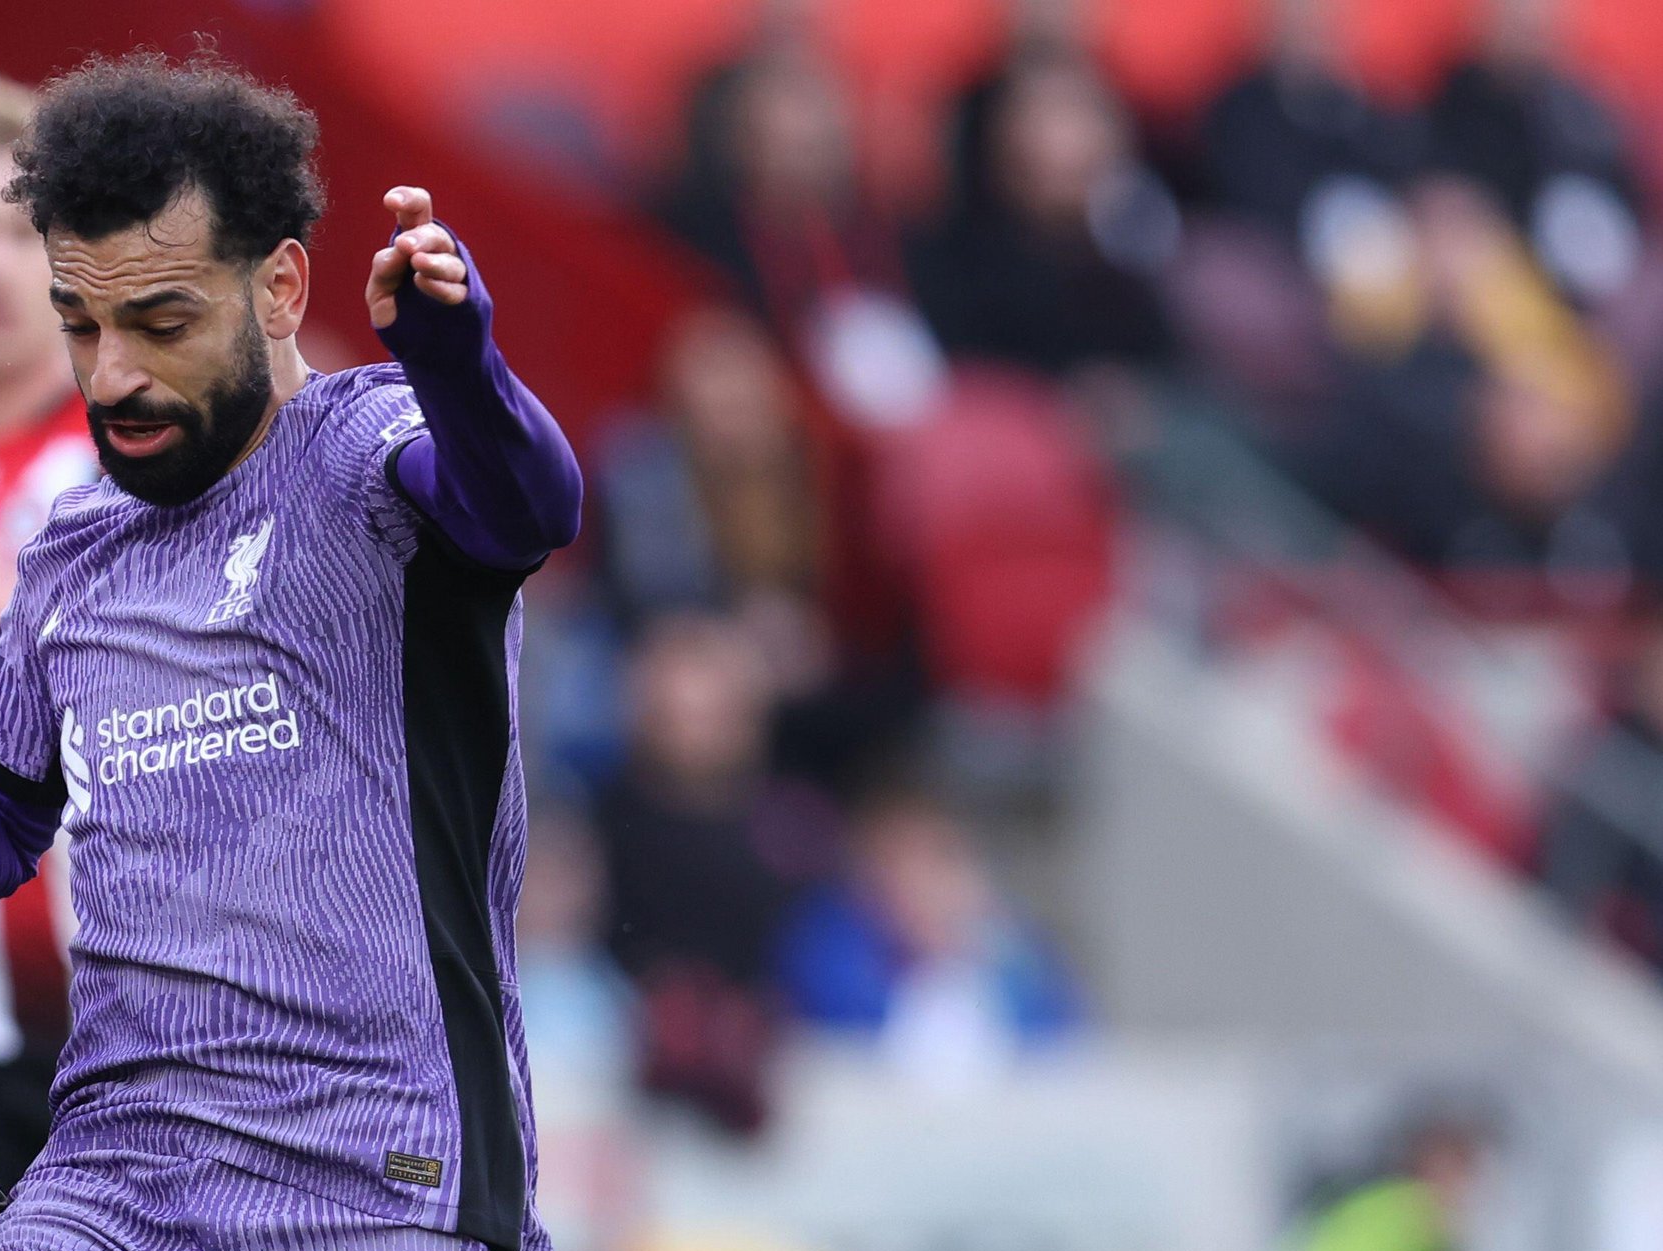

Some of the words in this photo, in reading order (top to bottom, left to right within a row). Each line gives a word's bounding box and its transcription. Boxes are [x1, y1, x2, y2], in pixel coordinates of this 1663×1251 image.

[204, 596, 252, 625] LFC
[97, 672, 280, 749] standard
[99, 708, 301, 786] chartered
